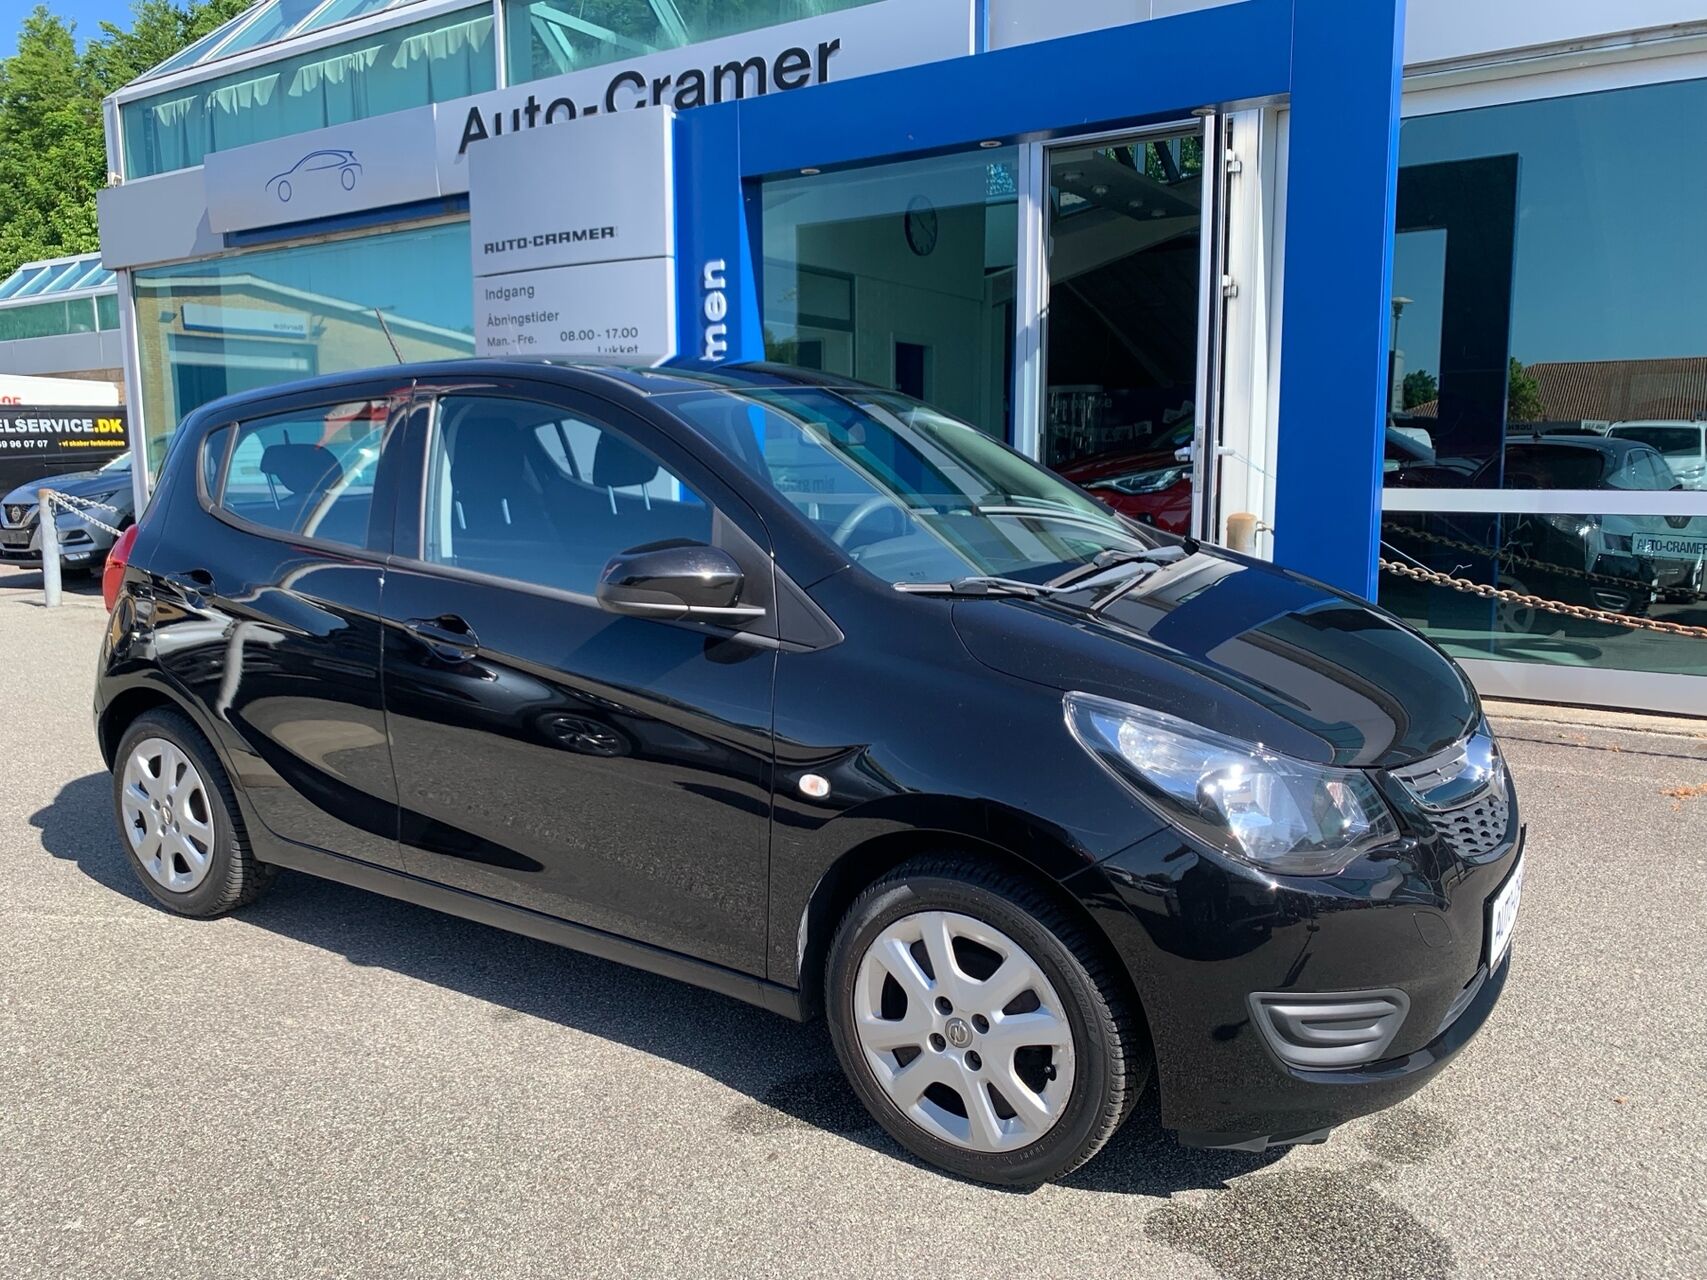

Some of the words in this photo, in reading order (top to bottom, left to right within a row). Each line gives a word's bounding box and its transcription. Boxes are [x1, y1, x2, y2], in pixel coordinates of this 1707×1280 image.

[458, 38, 841, 155] Auto-Cramer
[485, 285, 535, 301] Indgang
[487, 311, 559, 327] Åbningstider
[487, 337, 510, 347] Man.
[517, 334, 537, 345] Fre.
[560, 329, 595, 342] 08.00
[605, 327, 639, 339] 17.00
[0, 440, 8, 448] 9
[9, 440, 22, 448] 96
[23, 440, 34, 448] 07
[37, 440, 48, 448] 07
